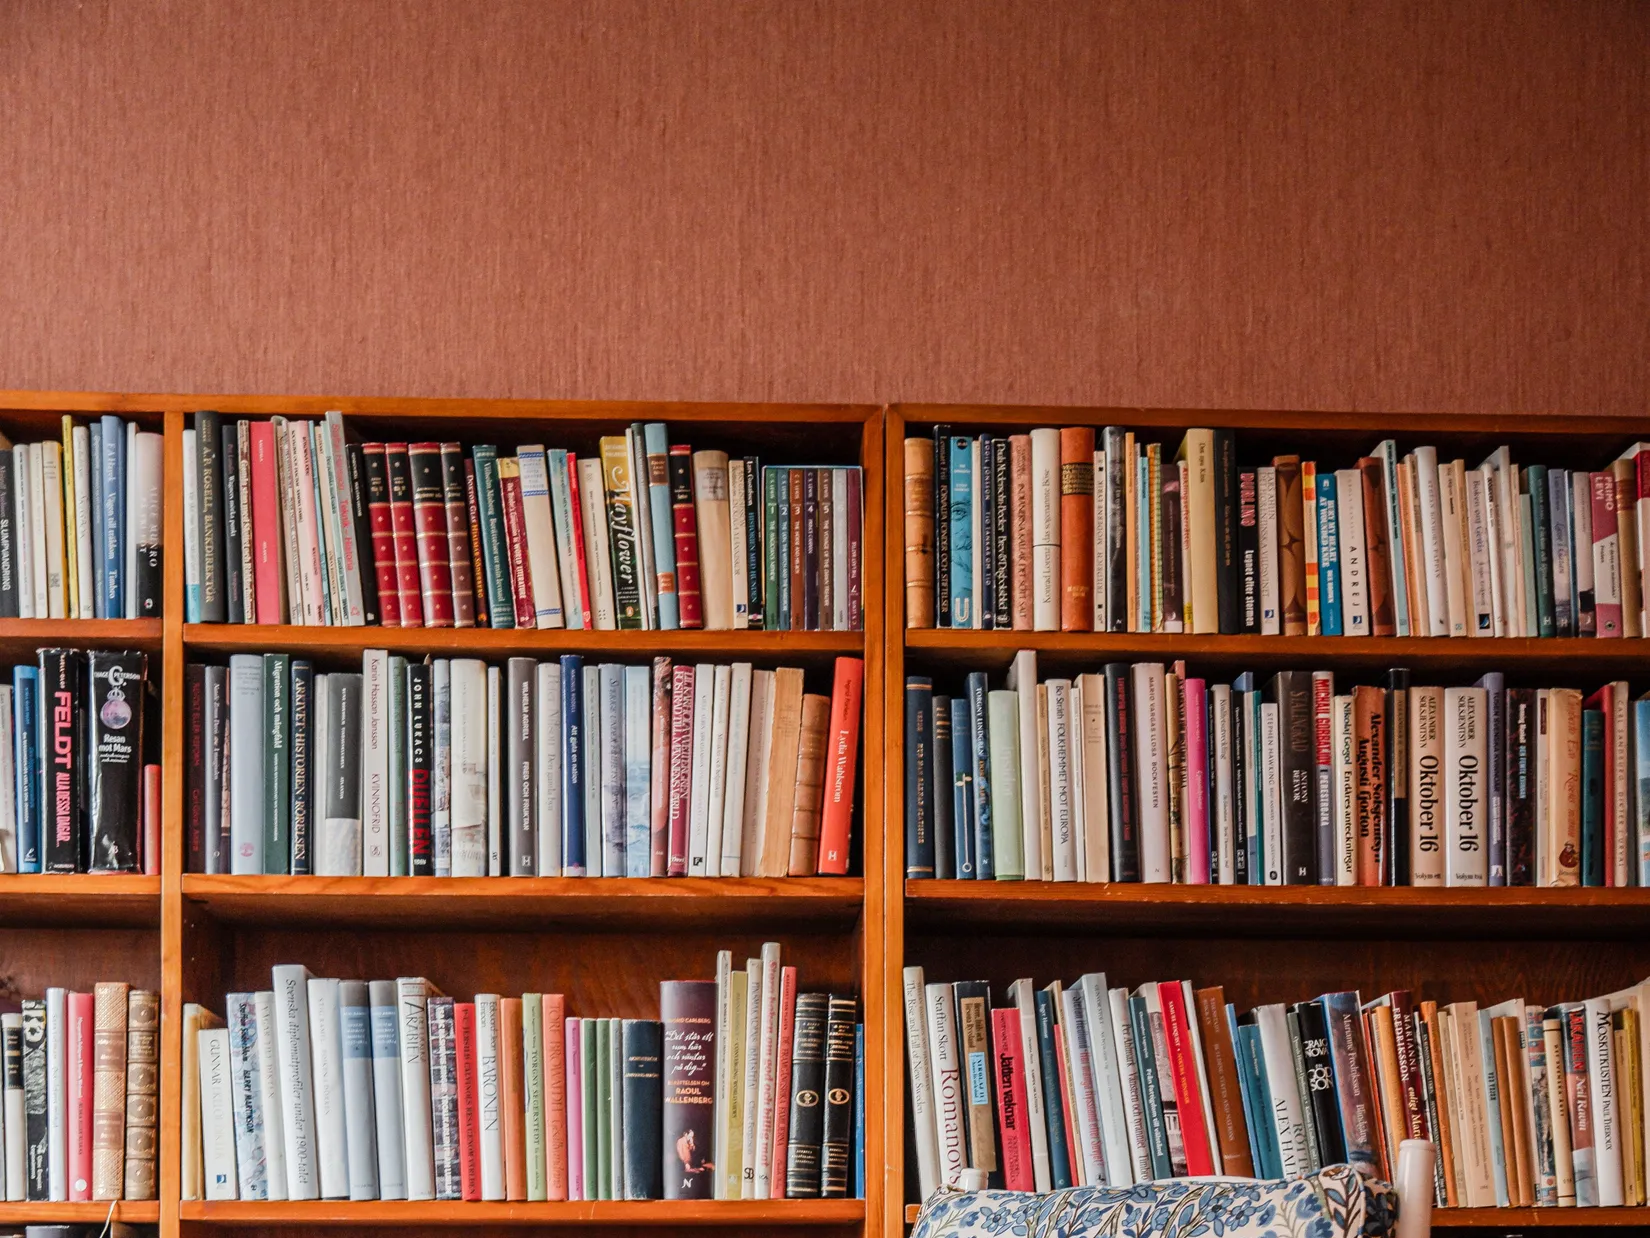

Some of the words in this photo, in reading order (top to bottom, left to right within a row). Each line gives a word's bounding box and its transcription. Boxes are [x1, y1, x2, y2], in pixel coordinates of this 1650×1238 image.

[1595, 477, 1604, 500] LEVI
[1604, 477, 1614, 511] PRIMO
[610, 466, 636, 584] Mayflower
[204, 515, 216, 603] BANKDIREKTÖR
[109, 569, 117, 599] Timbro
[371, 659, 380, 681] Karin
[274, 699, 282, 712] och
[295, 678, 306, 727] ARKIVET
[371, 684, 380, 715] Hassan
[413, 677, 422, 708] JOHN
[1056, 685, 1064, 696] Bo
[54, 691, 72, 769] FELDT
[371, 717, 380, 749] Jansson
[1342, 702, 1352, 735] Nikolaj
[1458, 695, 1467, 748] SOLSJENITSYN
[1468, 696, 1476, 740] ALEXANDER
[99, 744, 112, 752] mot
[113, 743, 132, 753] Mars
[104, 734, 126, 743] Resan
[414, 716, 423, 763] LUKACS
[837, 730, 849, 754] Lydia
[1057, 723, 1067, 782] FOLKHEMMET
[1343, 736, 1352, 765] Gogol
[1370, 711, 1382, 779] Alexander
[295, 734, 305, 794] HISTORIEN
[1344, 771, 1352, 782] En
[1356, 737, 1370, 786] Augusti
[833, 757, 847, 802] Wahlström
[1059, 786, 1068, 806] MOT
[1293, 770, 1301, 802] BEEVOR
[1344, 784, 1354, 809] dåres
[1420, 755, 1439, 830] Oktober
[1459, 755, 1479, 830] Oktober
[371, 773, 381, 834] KVINNOFRID
[412, 769, 430, 854] DUELLEN
[1320, 774, 1330, 826] PERESTROJKA
[1358, 790, 1370, 837] fjorton
[295, 801, 307, 860] RÖRELSEN
[1060, 809, 1069, 844] EUROPA
[1343, 811, 1352, 874] anteckningar
[1420, 834, 1440, 852] 16
[1459, 834, 1479, 852] 16
[285, 979, 297, 1018] Svenska
[906, 981, 916, 996] The
[907, 998, 918, 1016] Rise
[910, 1017, 920, 1031] and
[934, 995, 948, 1032] Staffan
[910, 1034, 921, 1049] Fall
[938, 1034, 949, 1060] Skott
[1342, 1014, 1354, 1051] Marianne
[1392, 1008, 1409, 1082] FREDRIKSSON
[1404, 1014, 1417, 1072] MARIANNE
[210, 1039, 221, 1085] GUNNAR
[288, 1021, 303, 1098] diplomatprofiler
[912, 1050, 922, 1059] of
[912, 1061, 923, 1082] New
[1000, 1054, 1014, 1088] Jätten
[1596, 1011, 1612, 1099] MOSKITKUSTEN
[676, 1087, 702, 1095] RAOUL
[1145, 1068, 1154, 1083] Från
[1347, 1052, 1362, 1096] Fredriksson
[482, 1056, 498, 1131] BARONEN
[664, 1096, 713, 1104] WALLENBERG
[915, 1083, 925, 1114] Sweden
[1004, 1089, 1016, 1130] vaknar
[1602, 1100, 1610, 1117] PAUL
[294, 1103, 304, 1130] under
[940, 1068, 963, 1185] Romanovs
[1355, 1104, 1368, 1143] Blindgång
[1603, 1119, 1612, 1151] THEROUX
[295, 1135, 309, 1184] 1900-talet
